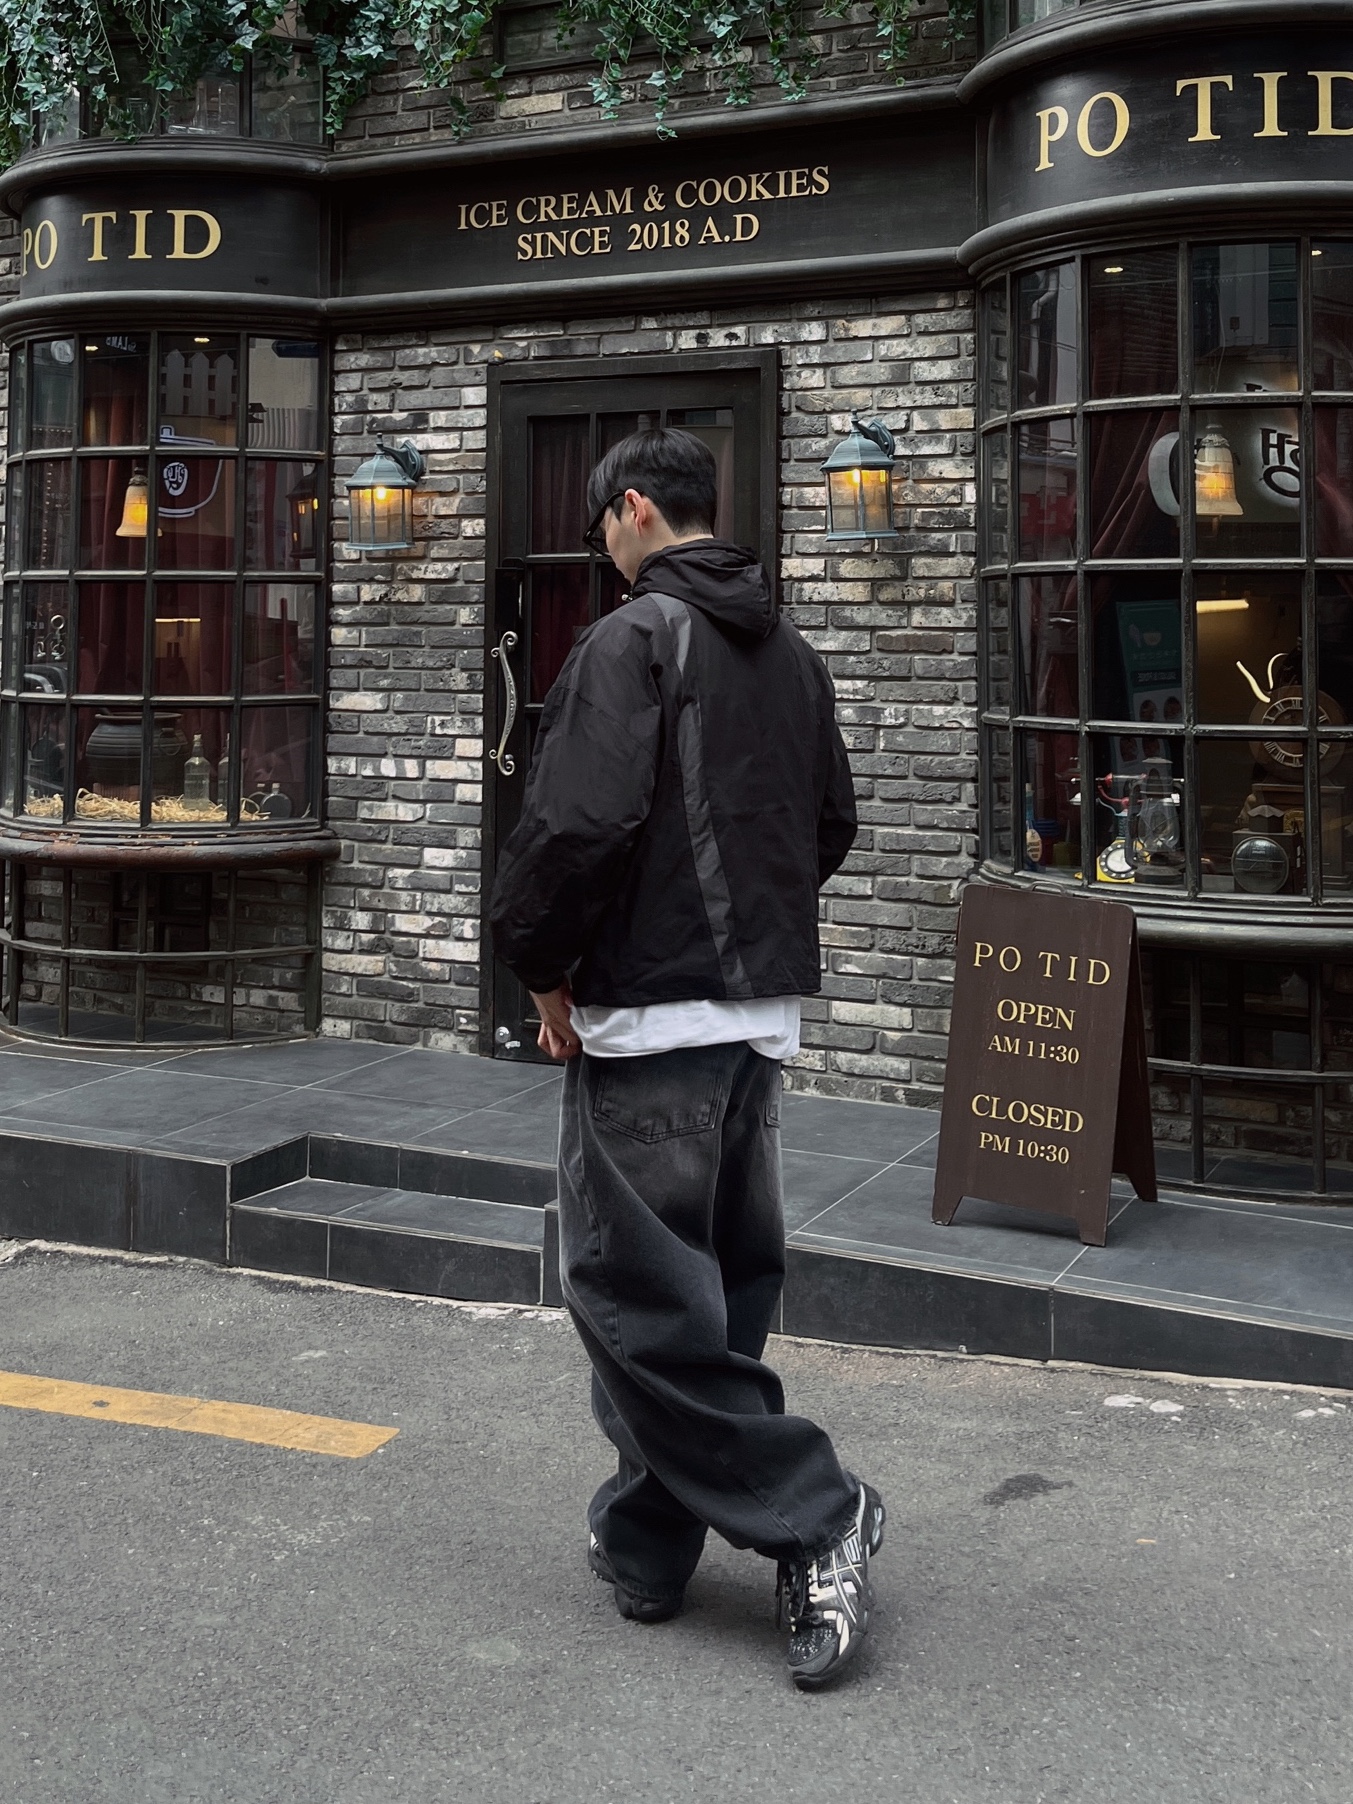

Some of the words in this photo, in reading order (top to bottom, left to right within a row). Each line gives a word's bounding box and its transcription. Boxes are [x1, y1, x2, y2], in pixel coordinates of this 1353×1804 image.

[1035, 91, 1130, 172] PO
[1176, 71, 1353, 142] TID
[457, 199, 508, 230] ICE
[516, 186, 634, 224] CREAM
[643, 184, 666, 212] &
[675, 165, 831, 209] COOKIES
[21, 219, 59, 277] PO
[81, 209, 222, 262] TID
[517, 226, 612, 261] SINCE
[627, 218, 690, 251] 2018
[698, 212, 760, 245] A.D
[972, 941, 1022, 972] PO
[1038, 951, 1111, 985] TID
[996, 998, 1076, 1031] OPEN
[987, 1034, 1021, 1055] AM
[1026, 1040, 1080, 1065] 11:30
[971, 1094, 1084, 1133] CLOSED
[979, 1131, 1011, 1154] PM
[1016, 1139, 1070, 1165] 10:30
